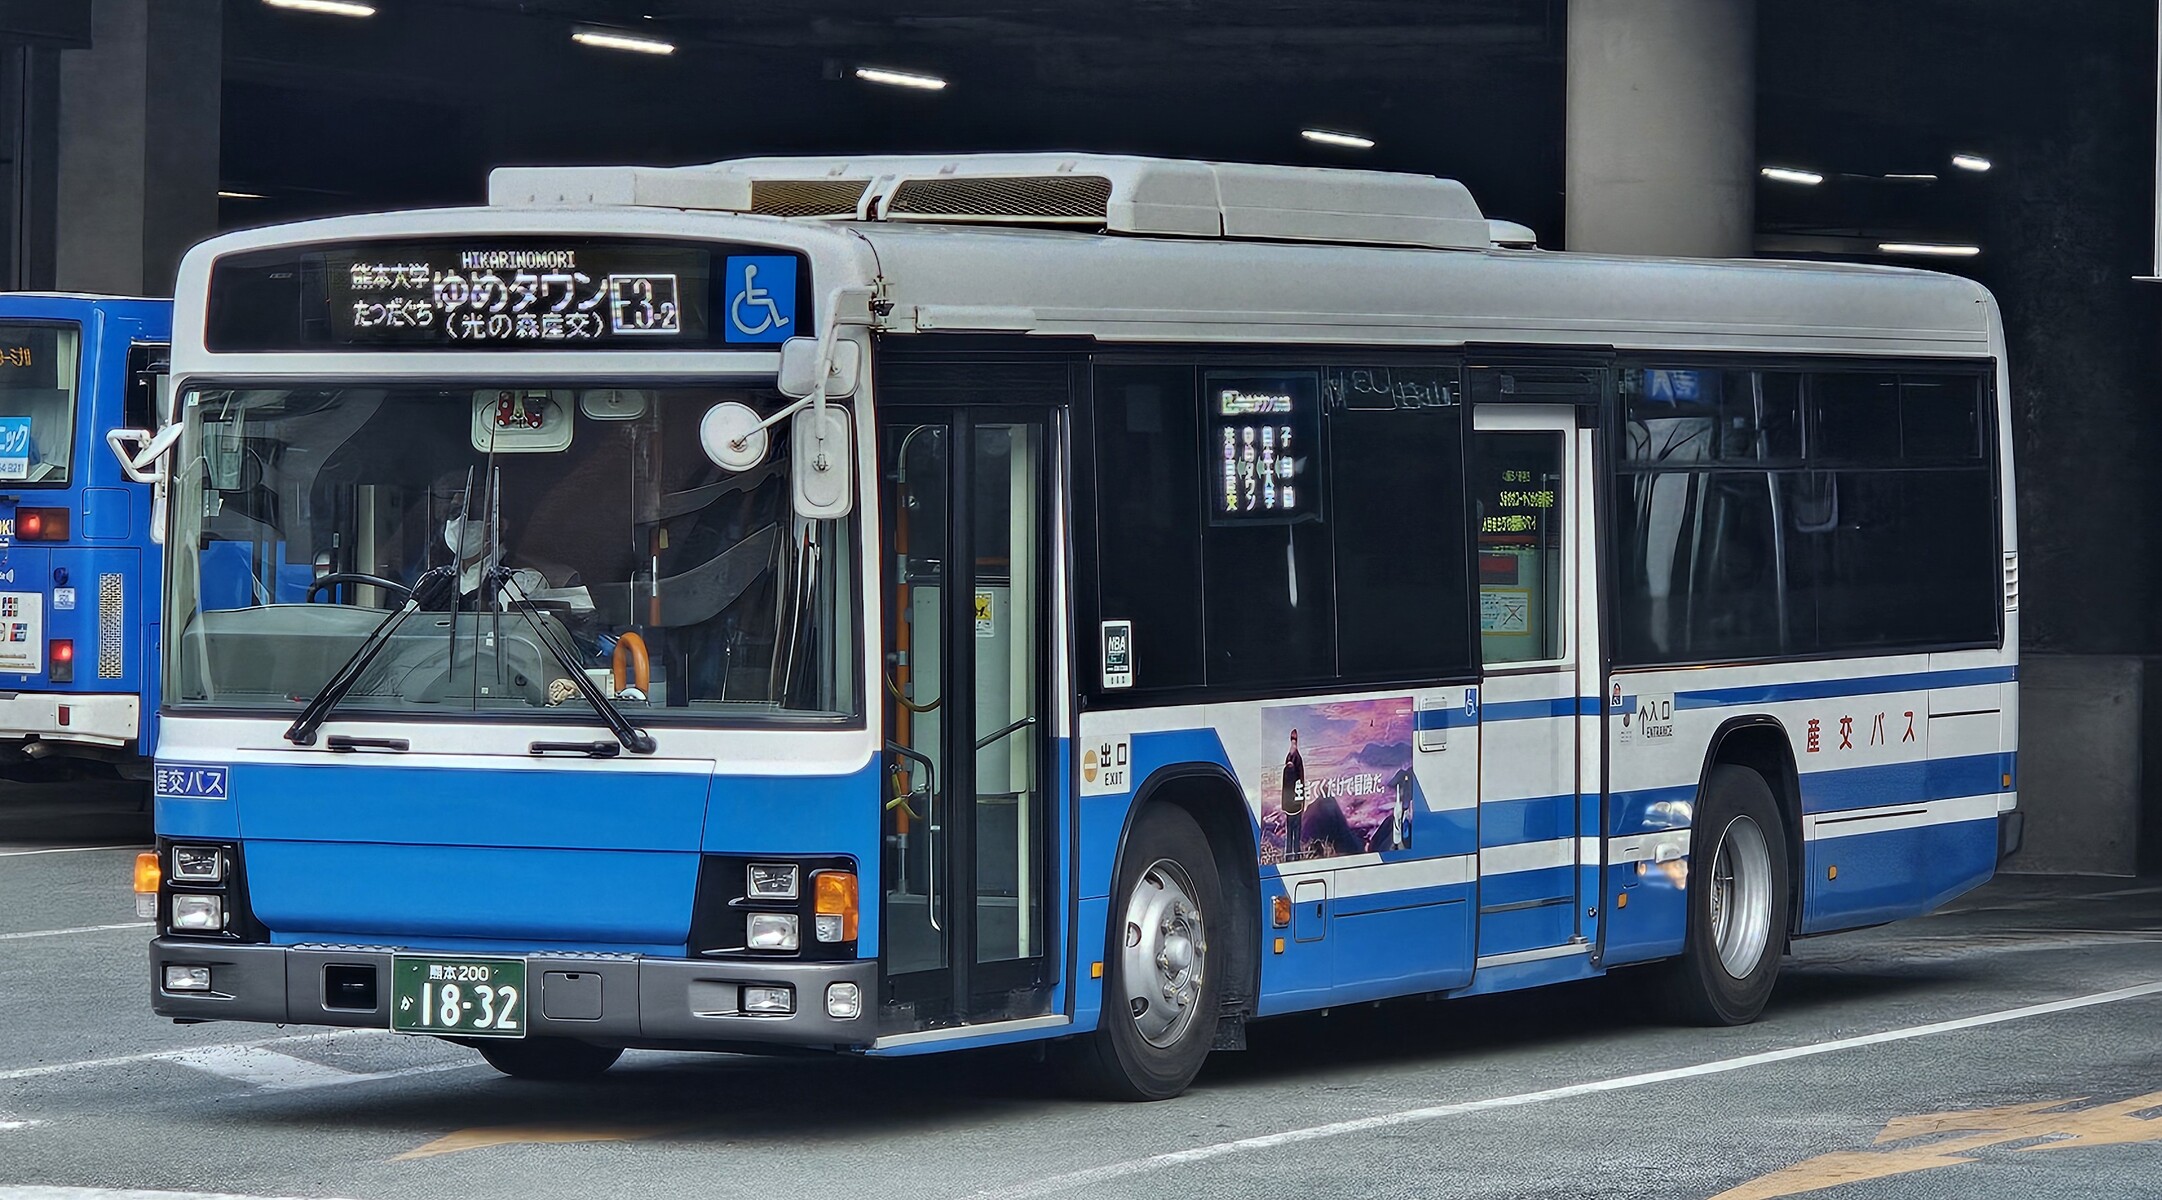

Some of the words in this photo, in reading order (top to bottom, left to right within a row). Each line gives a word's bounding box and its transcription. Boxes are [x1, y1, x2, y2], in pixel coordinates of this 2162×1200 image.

[461, 251, 575, 269] HIKARINOMORI
[350, 263, 430, 290] 熊本大学
[433, 269, 608, 313] ゆめタウン
[612, 278, 678, 328] E3-2
[352, 298, 434, 327] たつだぐち
[1648, 700, 1670, 721] 入口
[1806, 711, 1916, 753] 産交バス
[1100, 742, 1127, 768] 出口
[157, 769, 224, 795] 産交バス
[1104, 771, 1124, 786] EXIT
[429, 964, 489, 982] 熊本200
[422, 982, 518, 1029] 18-32
